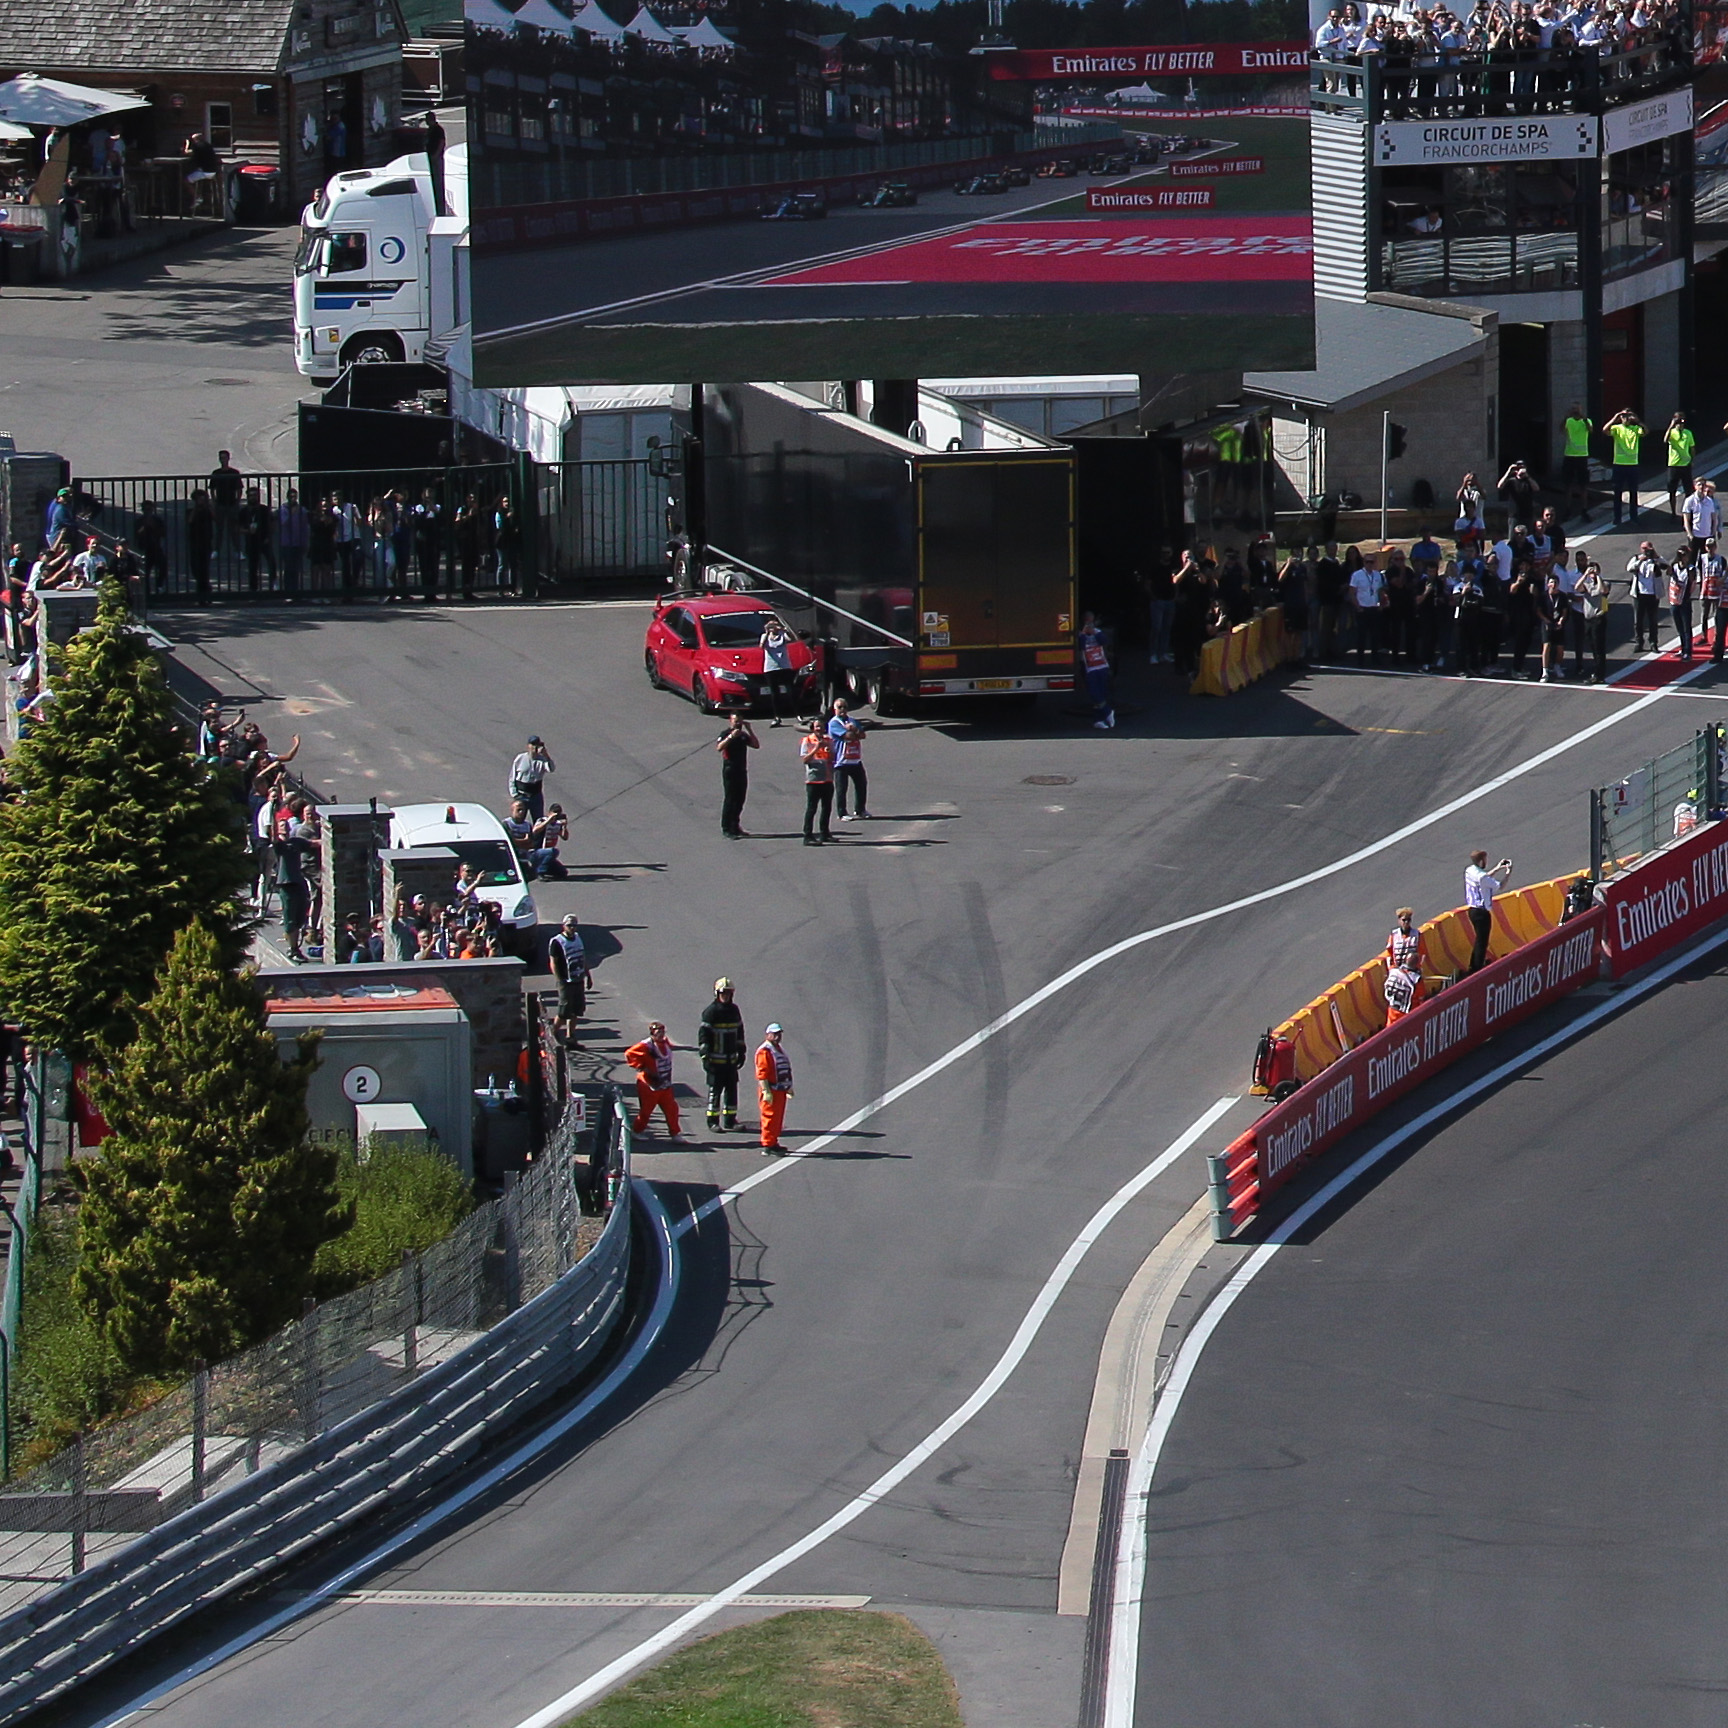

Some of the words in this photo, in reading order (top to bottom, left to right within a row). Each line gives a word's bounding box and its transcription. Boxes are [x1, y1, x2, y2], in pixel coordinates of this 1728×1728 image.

[1052, 56, 1137, 74] Emirates
[1144, 53, 1168, 72] FLY
[1168, 52, 1215, 71] BETTER
[1423, 127, 1487, 142] CIRCUIT
[1492, 126, 1514, 140] DE
[1517, 124, 1548, 139] SPA
[1422, 143, 1549, 159] FRANCORCHAMPS
[1172, 163, 1220, 176] Emirates
[1091, 193, 1153, 207] Emirates
[1158, 192, 1174, 206] FLY
[1174, 191, 1211, 206] BETTER
[1616, 876, 1689, 951] Emirates
[1693, 853, 1709, 908] FLY
[1485, 963, 1542, 1024] Emirates
[1546, 943, 1562, 989] FLY
[1563, 924, 1594, 978] BETTER
[1368, 1035, 1419, 1100] Emirates
[1424, 1020, 1438, 1062] FLY
[1439, 999, 1469, 1053] BETTER
[356, 1076, 367, 1093] 2
[1267, 1117, 1312, 1178] Emirates
[1315, 1092, 1328, 1140] FLY
[1329, 1075, 1353, 1131] BETTER
